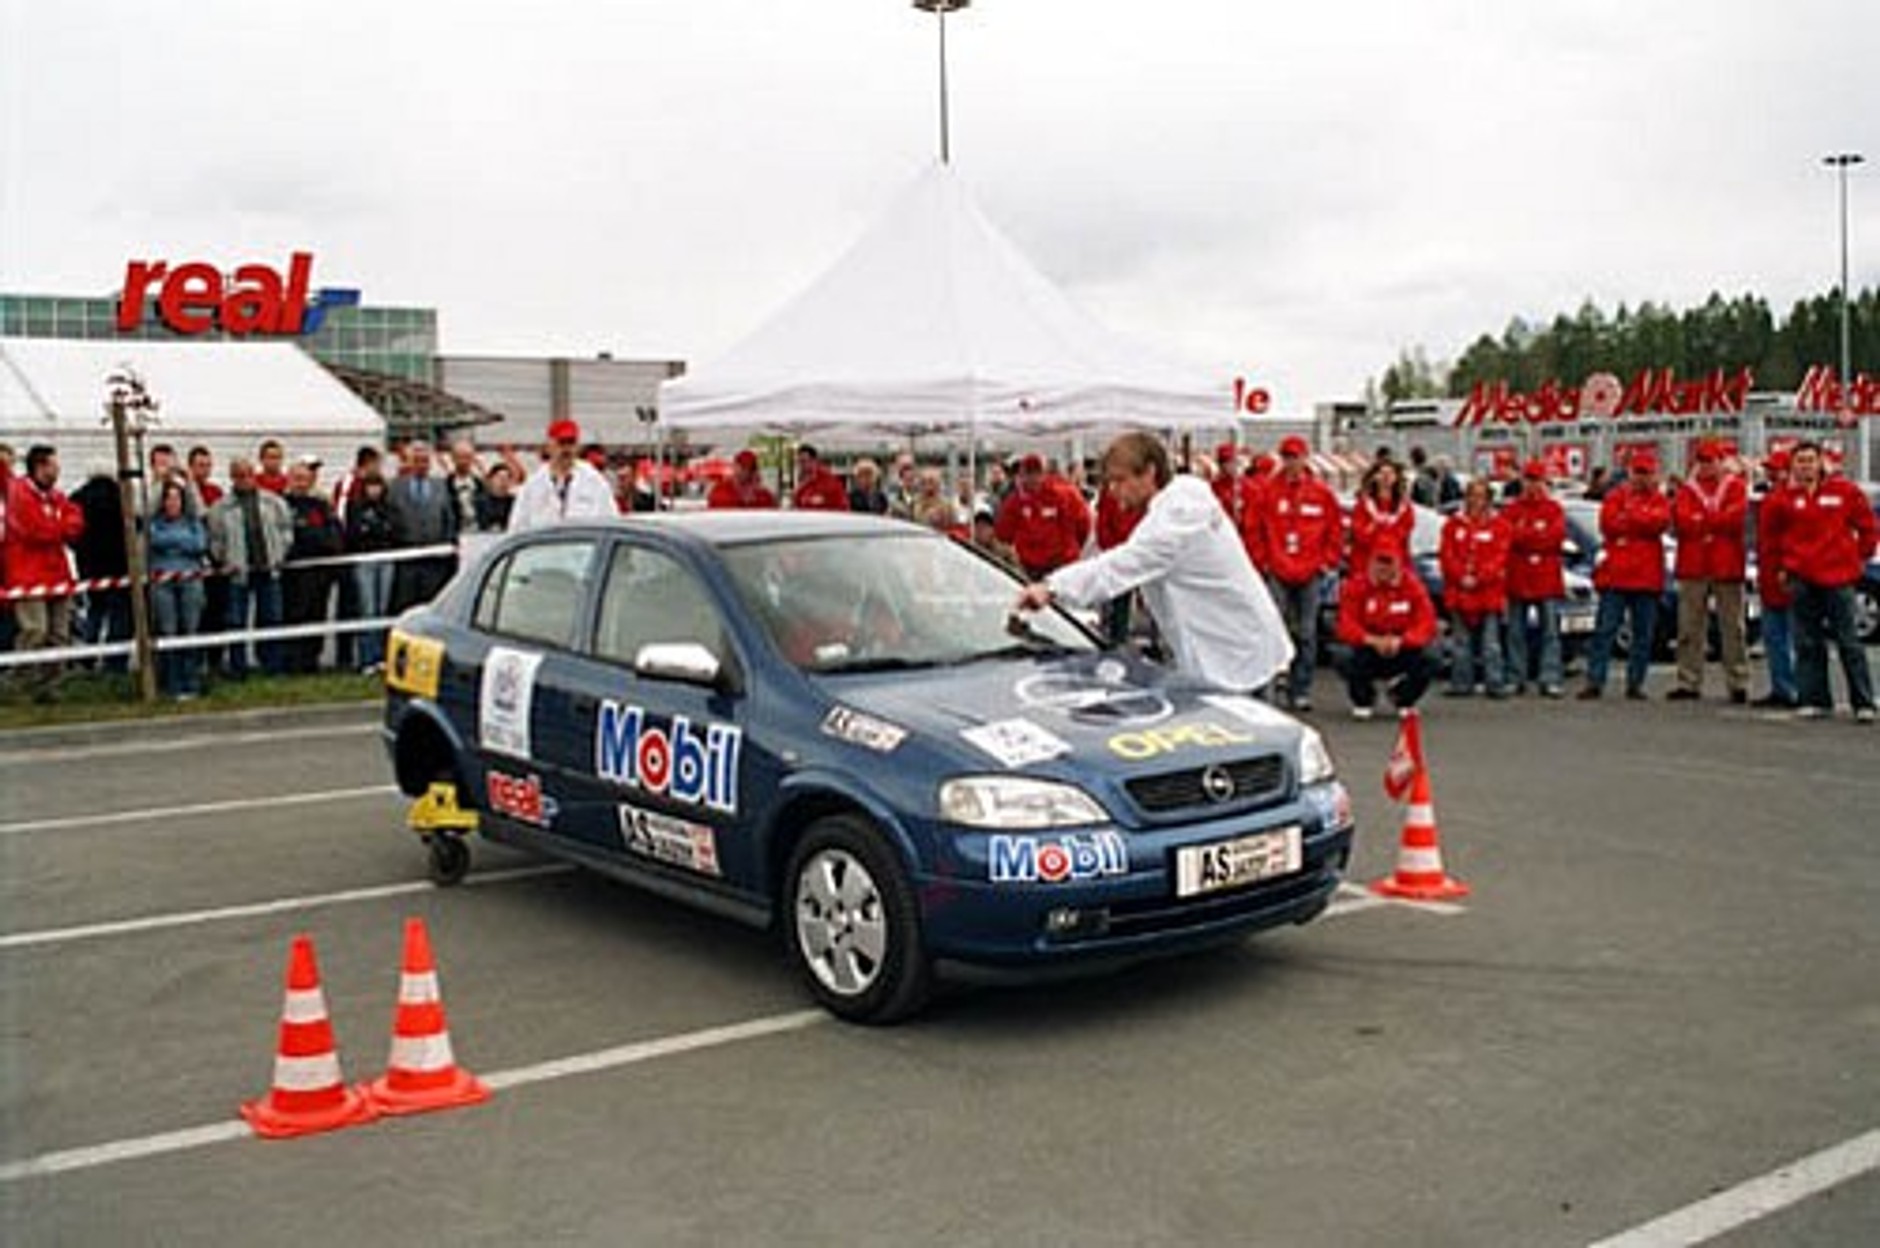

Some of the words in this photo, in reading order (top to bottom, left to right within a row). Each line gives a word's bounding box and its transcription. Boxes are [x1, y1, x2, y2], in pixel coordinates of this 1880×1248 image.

[1454, 376, 1585, 426] Media
[1610, 364, 1753, 416] Markt
[598, 699, 742, 813] Mobil
[1108, 722, 1253, 760] OPEL
[989, 832, 1129, 882] Mobil
[1202, 845, 1230, 886] AS
